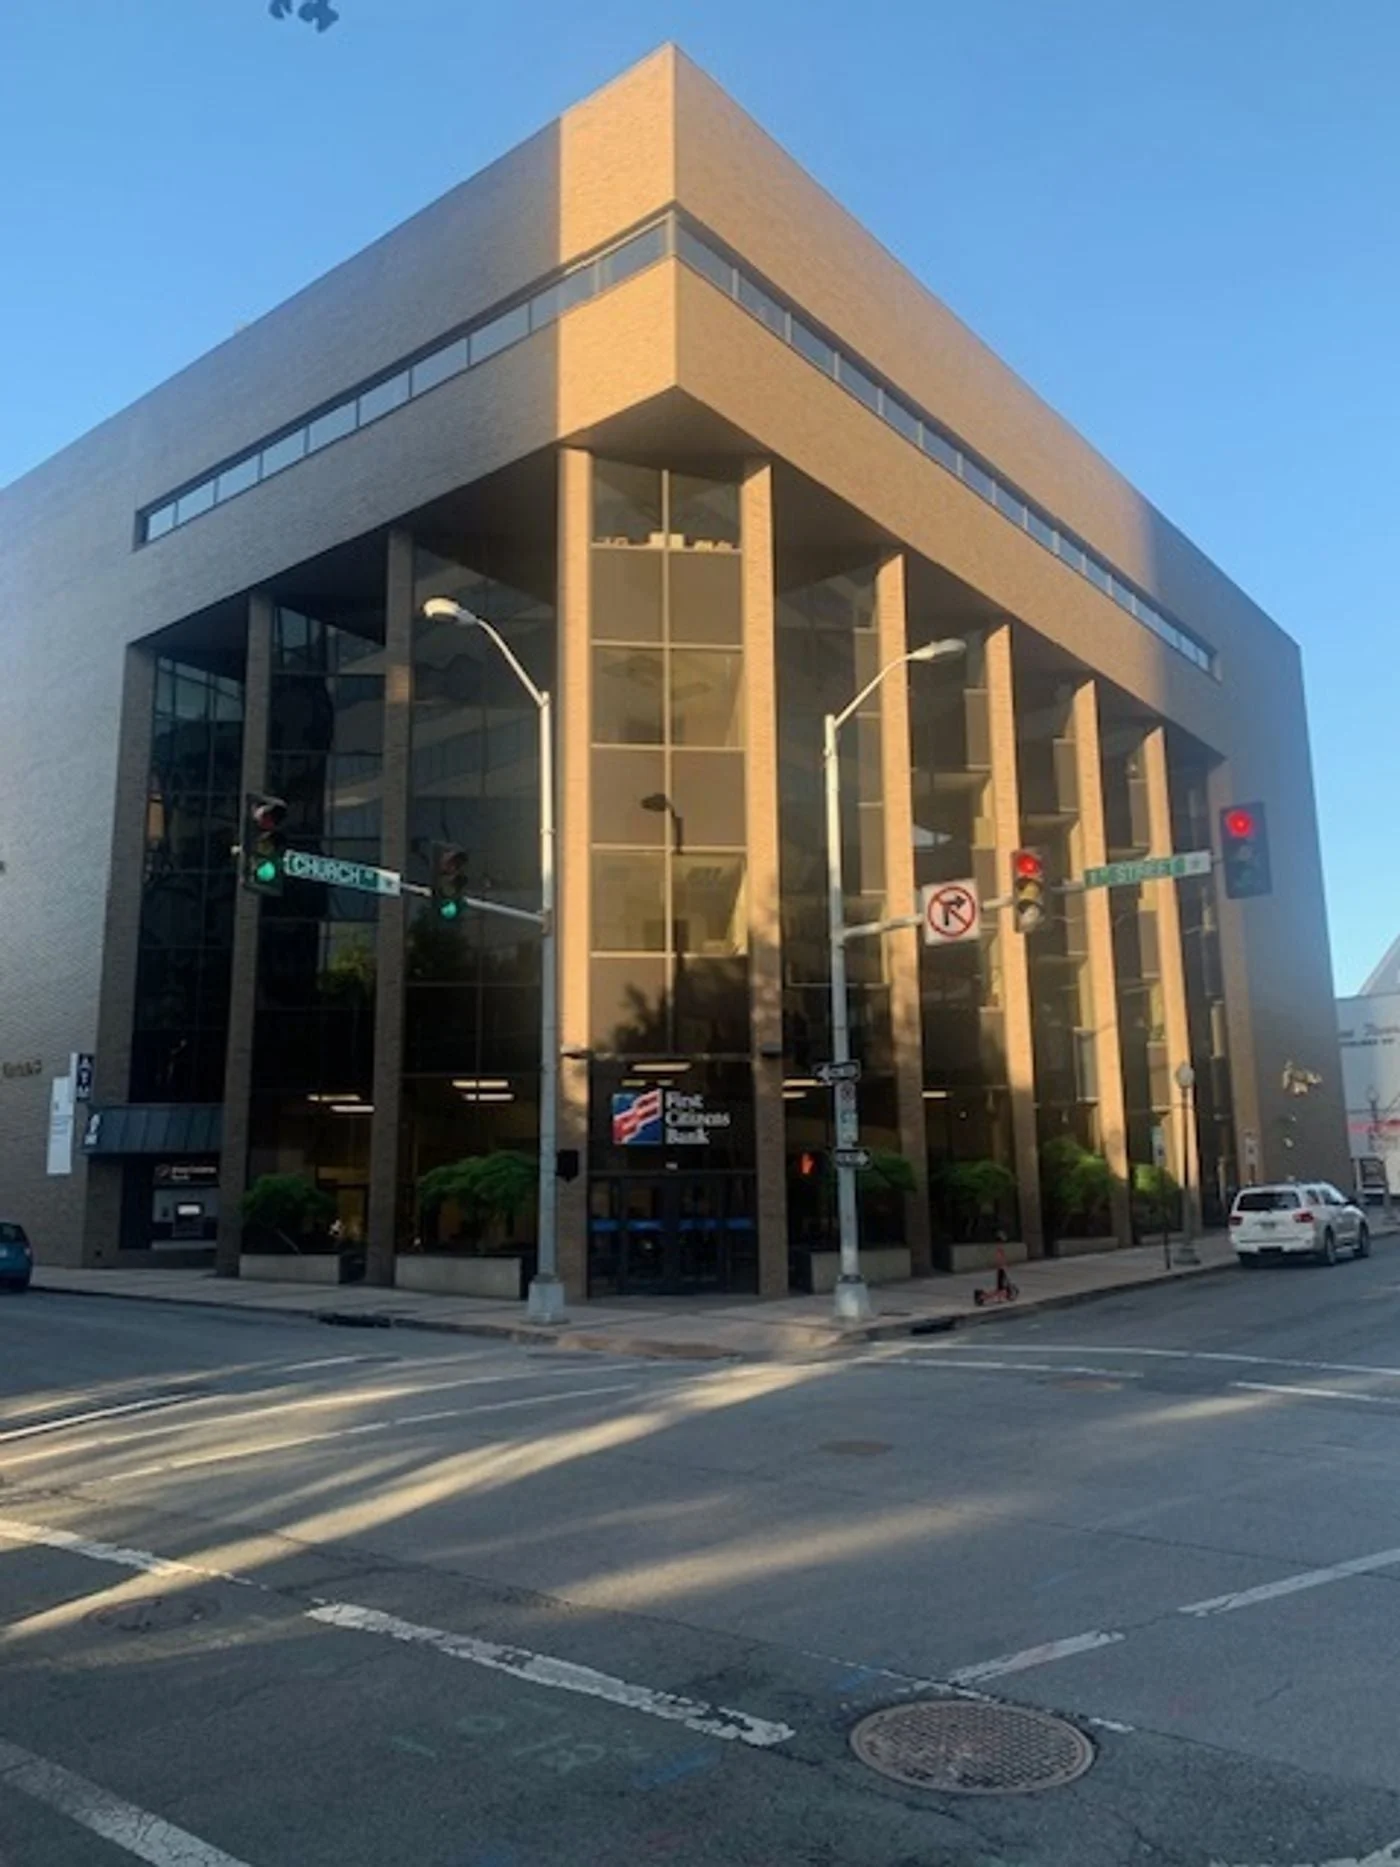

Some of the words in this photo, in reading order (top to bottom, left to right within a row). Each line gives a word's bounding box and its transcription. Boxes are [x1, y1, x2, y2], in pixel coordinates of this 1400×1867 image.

[291, 855, 360, 884] CHURCH
[665, 1091, 703, 1109] First
[665, 1109, 731, 1127] Citizens
[665, 1128, 710, 1144] Bank
